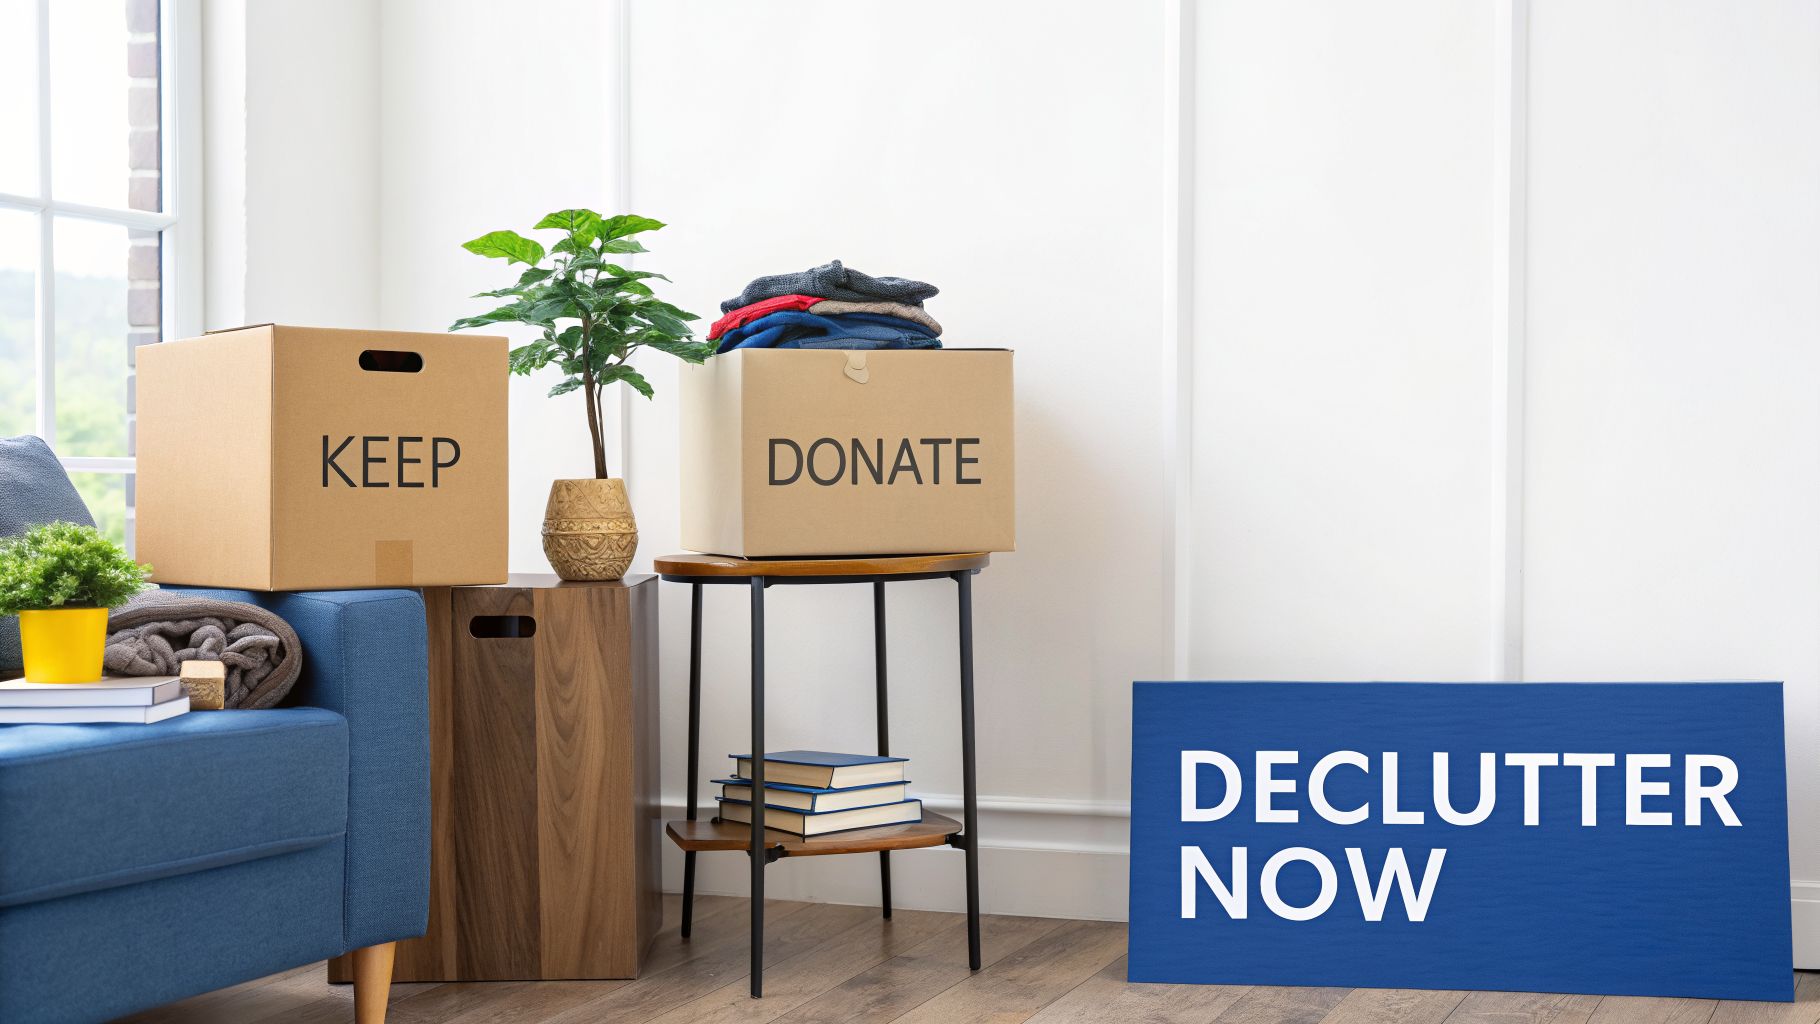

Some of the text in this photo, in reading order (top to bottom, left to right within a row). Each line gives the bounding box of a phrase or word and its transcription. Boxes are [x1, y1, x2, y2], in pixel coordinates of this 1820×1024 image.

[322, 435, 461, 488] KEEP
[768, 437, 982, 486] DONATE
[1180, 750, 1743, 827] DECLUTTER
[1180, 845, 1448, 922] NOW
